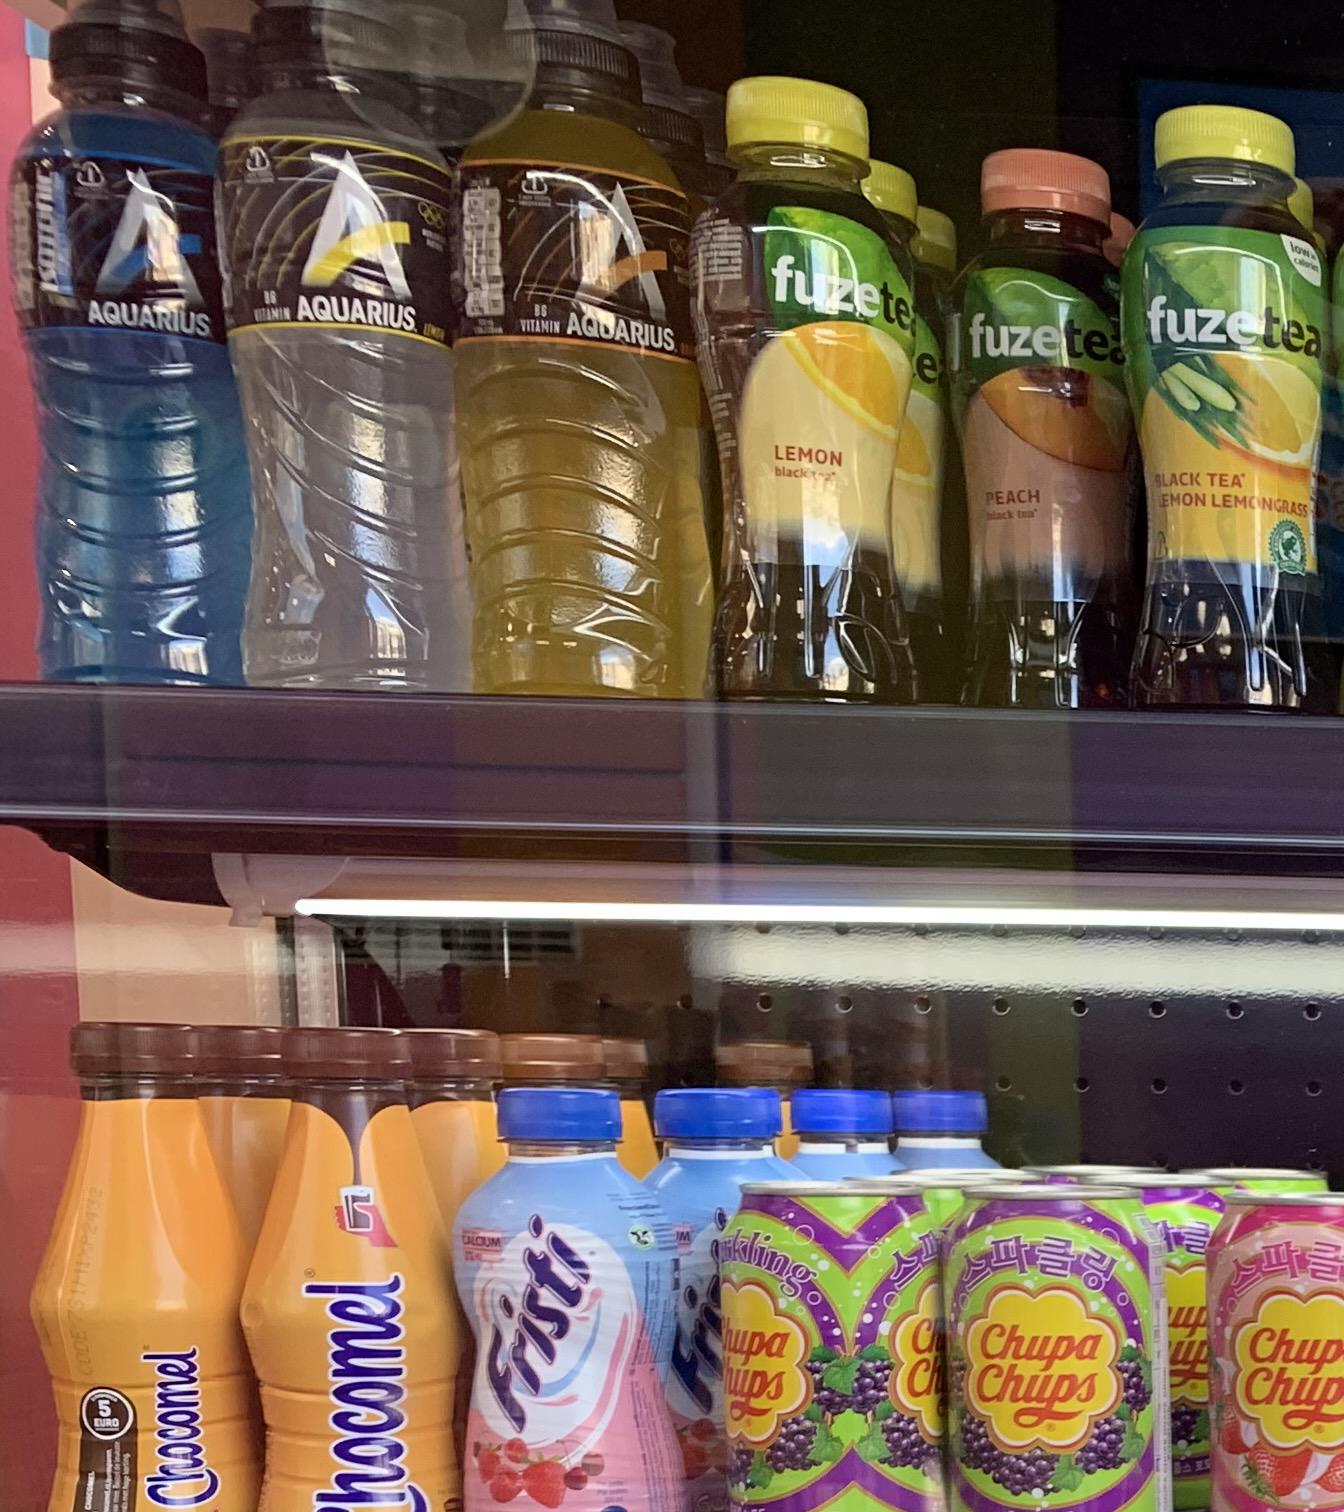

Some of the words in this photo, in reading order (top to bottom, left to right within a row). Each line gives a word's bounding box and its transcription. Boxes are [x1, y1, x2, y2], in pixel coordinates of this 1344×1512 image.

[88, 299, 211, 336] AQUARIUS
[297, 295, 417, 330] AQUARIUS
[520, 318, 561, 334] VITAMIN
[566, 312, 675, 351] AQUARIUS
[774, 445, 843, 467] LEMON
[985, 489, 1041, 506] PEACH
[1155, 472, 1201, 489] BLACK
[1160, 492, 1208, 508] LEMON
[1211, 493, 1309, 518] LEMONGRASS
[960, 1235, 1120, 1293] 스파클링
[487, 1212, 591, 1435] Fristi
[721, 1314, 788, 1371] hupa
[980, 1323, 1104, 1372] Chupa
[976, 1363, 1100, 1410] Chups
[98, 1399, 112, 1418] 5
[143, 1346, 219, 1507] Chocomel
